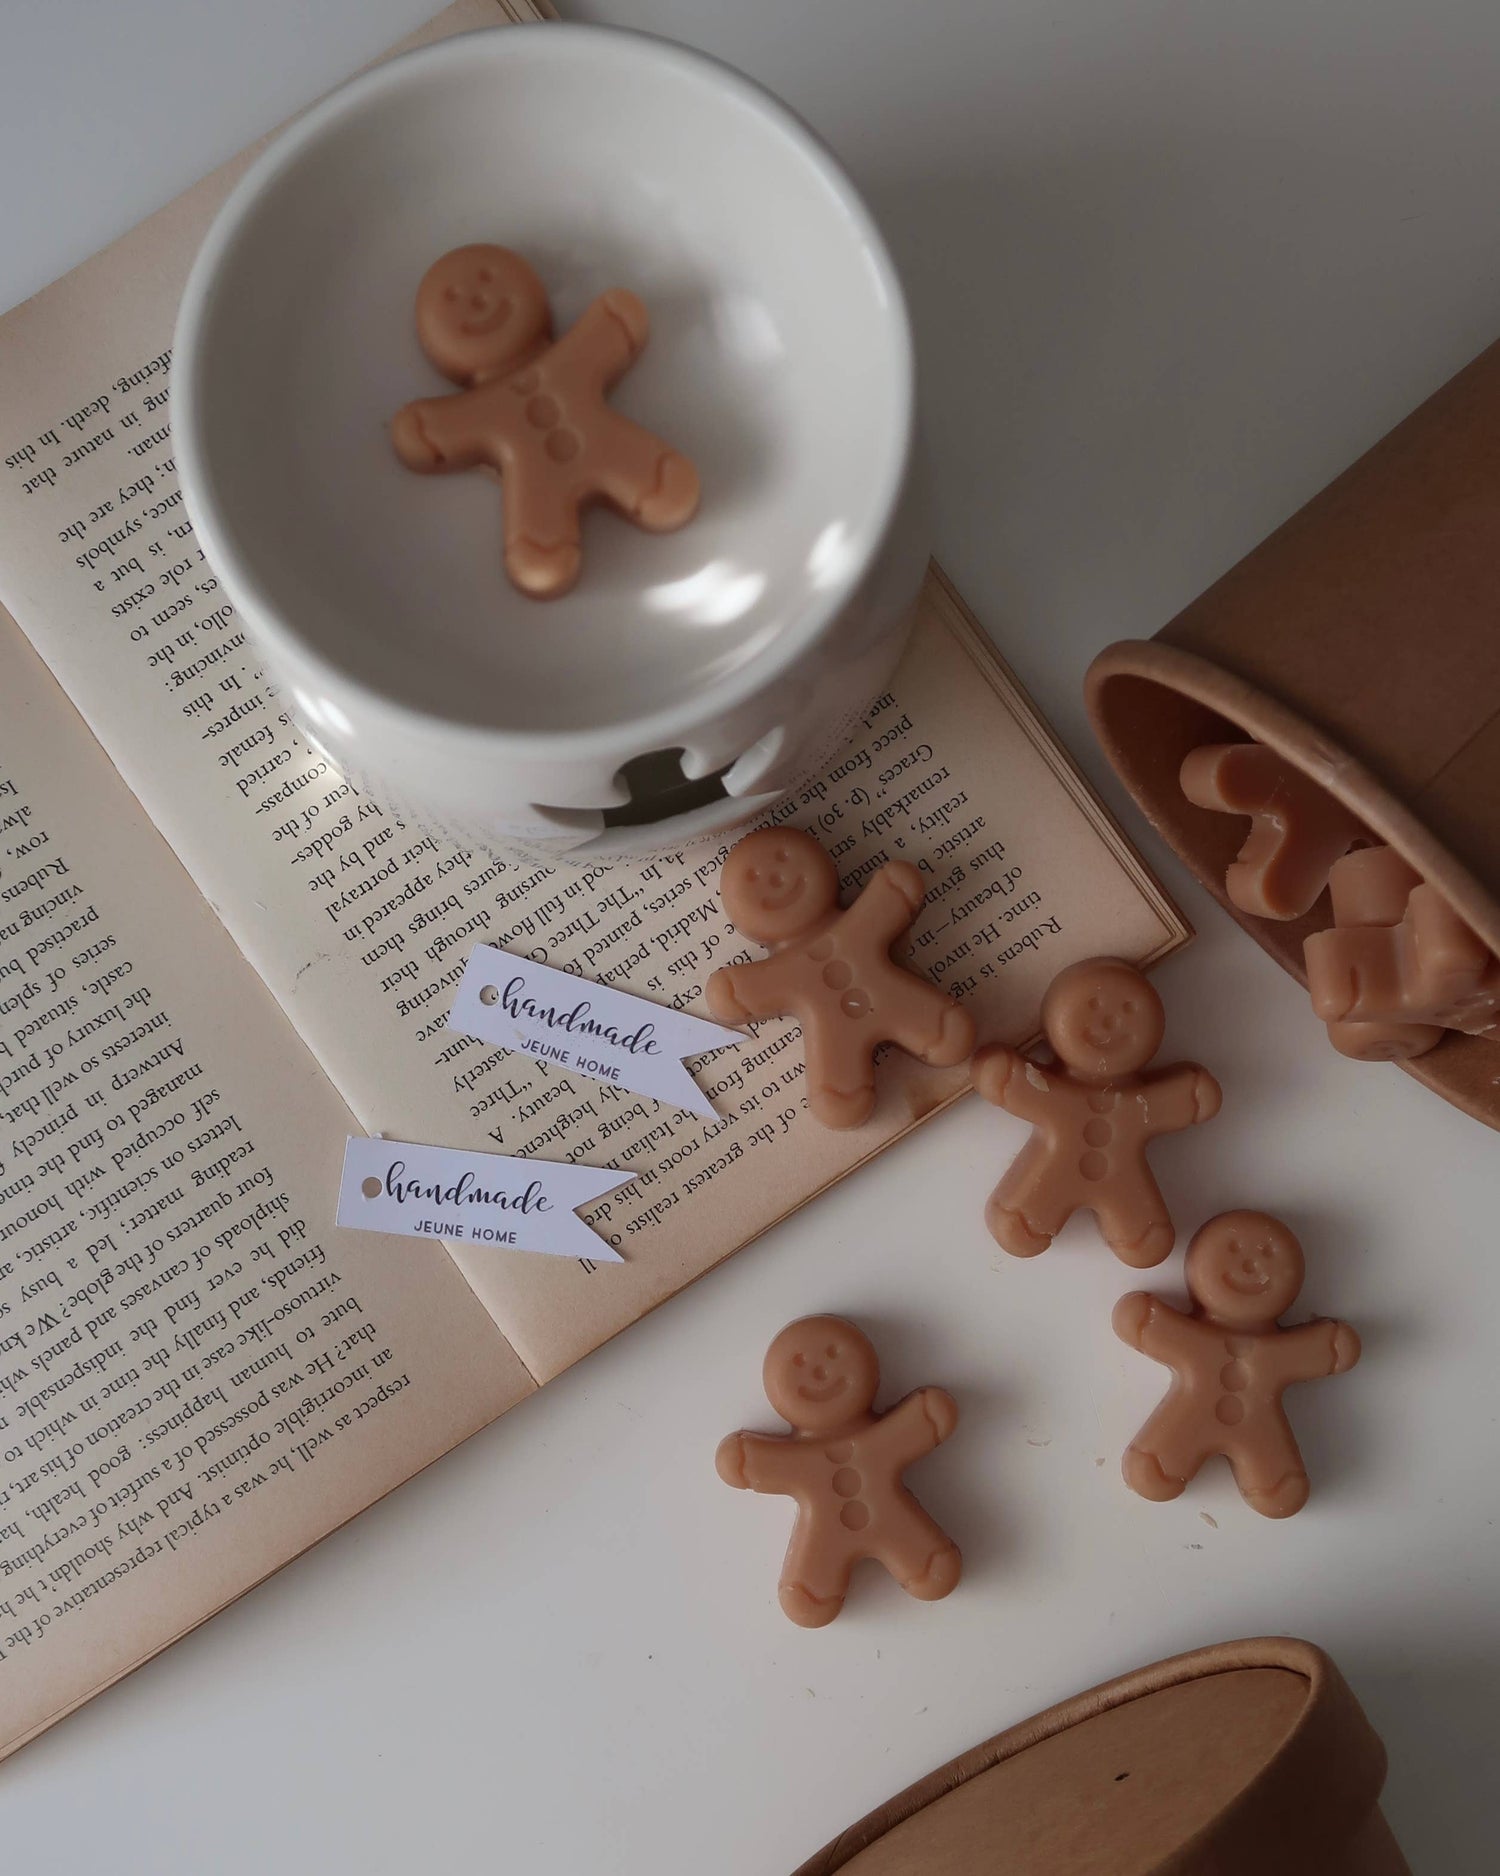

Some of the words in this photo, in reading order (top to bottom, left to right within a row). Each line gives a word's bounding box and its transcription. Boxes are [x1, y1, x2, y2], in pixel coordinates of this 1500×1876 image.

[59, 394, 111, 432] death.
[117, 409, 142, 429] in
[36, 428, 62, 447] In
[61, 426, 116, 468] nature
[3, 443, 37, 470] this
[20, 466, 57, 495] that
[117, 473, 155, 505] they
[86, 499, 115, 523] are
[56, 519, 87, 543] the
[74, 517, 143, 570] symbols
[147, 540, 167, 557] is
[108, 556, 146, 582] but
[157, 556, 194, 587] role
[109, 582, 156, 618] exists
[148, 593, 194, 627] seem
[128, 623, 150, 642] to
[145, 643, 176, 668] the
[181, 691, 214, 718] this
[200, 693, 267, 740] impres-
[216, 723, 275, 768] female
[870, 712, 914, 752] piece
[234, 748, 292, 798] carried
[826, 747, 873, 783] from
[253, 761, 327, 815] compass-
[798, 780, 828, 805] the
[860, 765, 951, 838] remarkably
[270, 817, 300, 842] the
[298, 804, 320, 834] of
[909, 789, 969, 834] reality,
[5, 829, 50, 860] row,
[289, 813, 354, 865] goddes-
[360, 826, 394, 860] and
[931, 815, 986, 860] artistic
[968, 840, 1006, 871] thus
[0, 855, 71, 903] Rubens
[306, 867, 336, 892] the
[338, 850, 366, 873] by
[637, 862, 664, 882] In
[17, 883, 85, 928] vincing
[323, 855, 400, 924] portrayal
[359, 873, 434, 936] appeared
[561, 879, 586, 899] in
[641, 876, 693, 914] series,
[997, 890, 1042, 923] time.
[406, 893, 465, 935] brings
[531, 893, 566, 927] full
[648, 897, 719, 953] Madrid,
[23, 903, 100, 967] practised
[340, 922, 366, 942] in
[422, 908, 492, 963] through
[546, 909, 601, 949] Three
[580, 908, 643, 968] painted
[698, 933, 721, 961] of
[970, 921, 1002, 946] He
[995, 914, 1063, 966] Rubens
[70, 933, 117, 969] series
[358, 931, 406, 966] them
[666, 949, 699, 977] this
[80, 960, 133, 996] castle,
[378, 959, 420, 993] their
[645, 974, 665, 992] is
[978, 961, 998, 978] is
[121, 986, 152, 1009] the
[11, 994, 79, 1049] situated
[66, 1003, 127, 1048] luxury
[501, 976, 664, 1056] handmade
[100, 1010, 172, 1061] interests
[110, 1036, 185, 1091] Antwerp
[520, 1038, 571, 1064] JEUNE
[576, 1055, 622, 1081] HOME
[38, 1070, 80, 1106] well
[125, 1061, 204, 1124] managed
[188, 1087, 221, 1122] self
[510, 1078, 577, 1124] beauty.
[738, 1093, 764, 1115] its
[760, 1080, 781, 1099] to
[11, 1101, 80, 1159] princely
[185, 1113, 243, 1154] letters
[596, 1101, 650, 1140] being
[701, 1109, 740, 1144] very
[745, 1122, 776, 1147] the
[774, 1106, 797, 1134] of
[65, 1126, 105, 1164] find
[109, 1111, 186, 1172] occupied
[563, 1135, 597, 1166] not
[618, 1119, 676, 1162] Italian
[657, 1137, 701, 1174] roots
[35, 1152, 66, 1177] the
[189, 1139, 256, 1188] reading
[234, 1165, 274, 1198] four
[636, 1167, 662, 1186] in
[680, 1140, 744, 1195] greatest
[62, 1165, 108, 1199] with
[78, 1165, 159, 1221] scientific,
[385, 1160, 555, 1215] handmade
[612, 1180, 644, 1206] his
[118, 1185, 185, 1235] matter;
[164, 1190, 233, 1243] quarters
[212, 1191, 290, 1250] shiploads
[624, 1190, 681, 1235] realists
[14, 1219, 79, 1263] artistic,
[83, 1232, 119, 1264] led
[275, 1218, 307, 1250] did
[413, 1219, 465, 1238] JEUNE
[471, 1228, 518, 1245] HOME
[113, 1251, 144, 1276] the
[205, 1260, 243, 1292] ever
[259, 1242, 326, 1290] friends,
[19, 1269, 65, 1304] busy
[57, 1266, 115, 1319] globe?
[118, 1258, 190, 1311] canvases
[162, 1288, 201, 1325] find
[226, 1286, 261, 1321] and
[235, 1271, 343, 1346] virtuoso-like
[319, 1295, 364, 1327] bute
[83, 1305, 117, 1341] and
[127, 1317, 159, 1342] the
[173, 1308, 228, 1352] finally
[332, 1321, 377, 1361] that?
[29, 1324, 84, 1373] panels
[140, 1346, 171, 1372] the
[199, 1341, 235, 1369] ease
[227, 1341, 294, 1387] human
[14, 1339, 126, 1419] indispensable
[98, 1367, 141, 1399] time
[151, 1377, 182, 1402] the
[269, 1371, 305, 1399] was
[351, 1372, 411, 1420] respect
[136, 1384, 229, 1450] happiness:
[272, 1363, 373, 1435] incorrigible
[22, 1410, 79, 1452] which
[83, 1396, 153, 1446] creation
[192, 1388, 271, 1456] possessed
[195, 1430, 271, 1483] optimist.
[288, 1427, 335, 1463] well,
[7, 1470, 40, 1494] art,
[38, 1453, 70, 1478] his
[85, 1443, 132, 1489] good
[23, 1479, 88, 1523] health,
[105, 1465, 161, 1508] surfeit
[154, 1480, 194, 1519] And
[232, 1472, 269, 1499] was
[116, 1509, 156, 1541] why
[162, 1501, 222, 1552] typical
[0, 1514, 88, 1577] everything
[51, 1539, 164, 1618] representative
[3, 1625, 33, 1648] the
